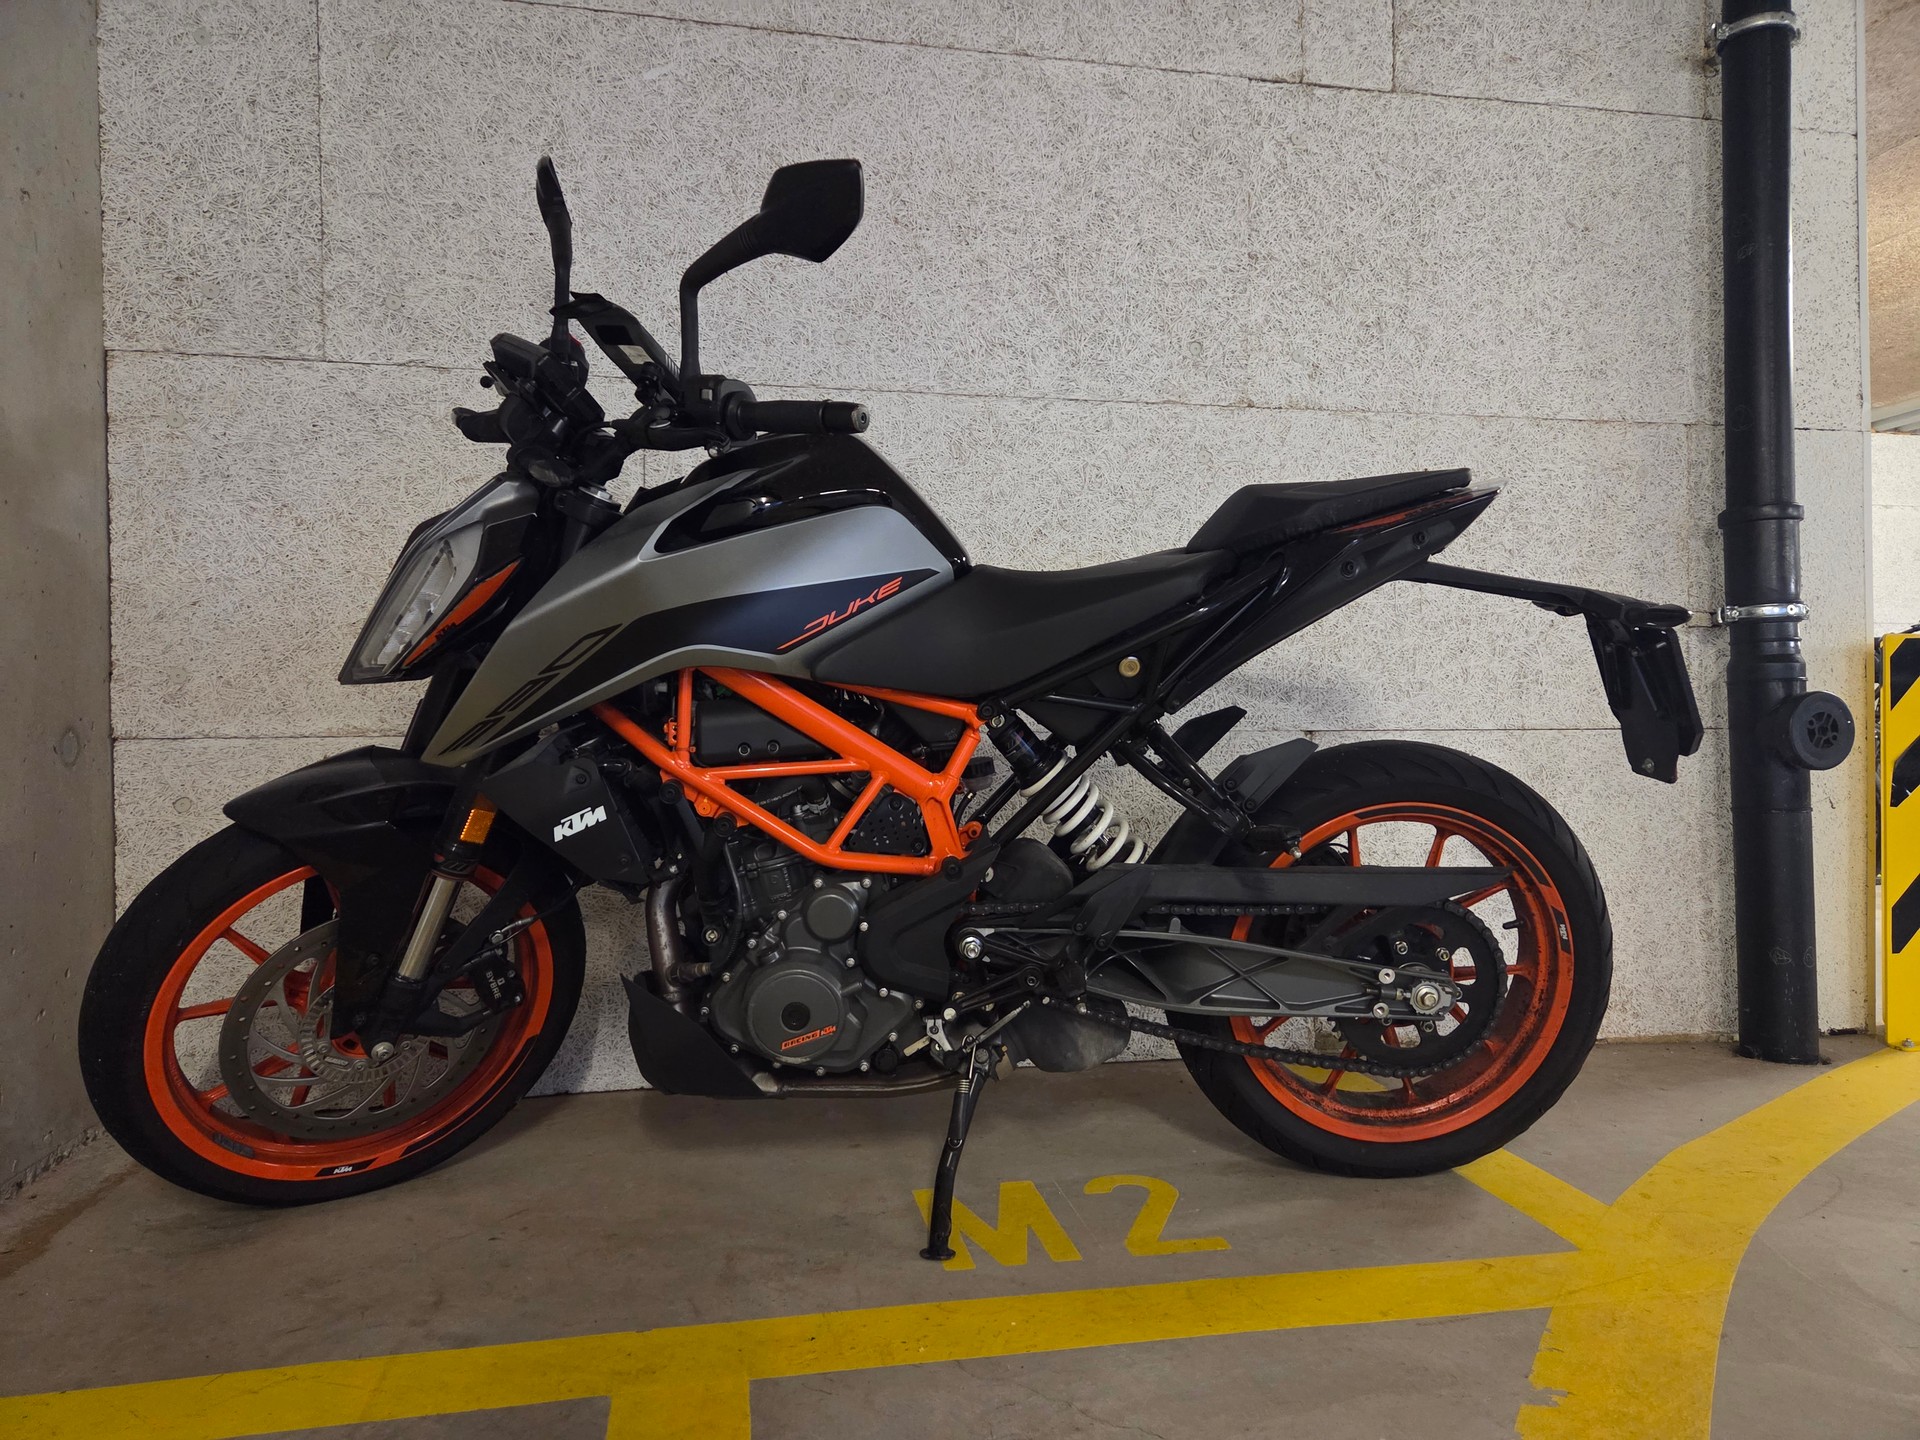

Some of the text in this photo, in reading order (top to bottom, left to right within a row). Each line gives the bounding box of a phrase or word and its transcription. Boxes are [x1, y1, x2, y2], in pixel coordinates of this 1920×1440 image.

[777, 576, 903, 650] DUKE
[553, 805, 607, 843] KTM
[485, 970, 502, 1000] BYBRE
[782, 1030, 820, 1050] RACING
[332, 1165, 353, 1175] KTM
